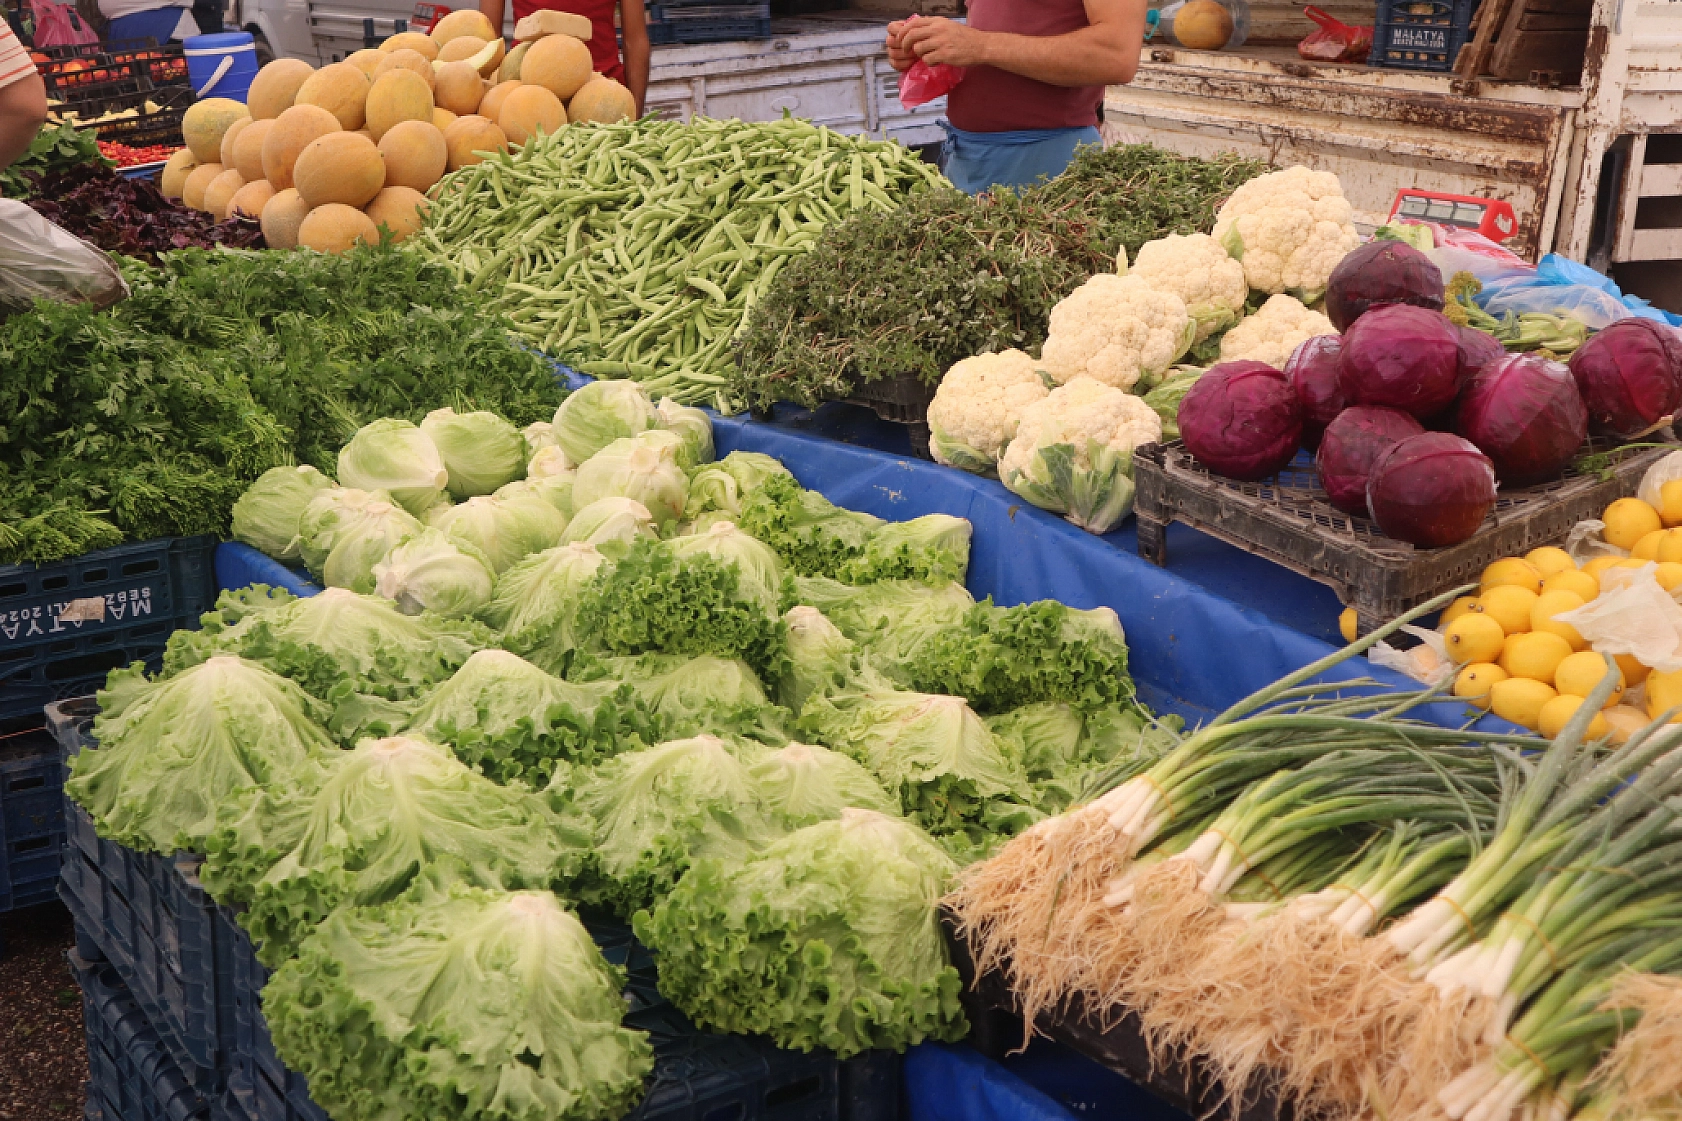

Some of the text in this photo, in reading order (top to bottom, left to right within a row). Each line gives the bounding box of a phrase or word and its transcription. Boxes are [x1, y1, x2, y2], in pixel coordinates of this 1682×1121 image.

[1393, 28, 1445, 42] MALATYA
[103, 587, 152, 606] SEBZ
[1, 599, 152, 640] MATYA
